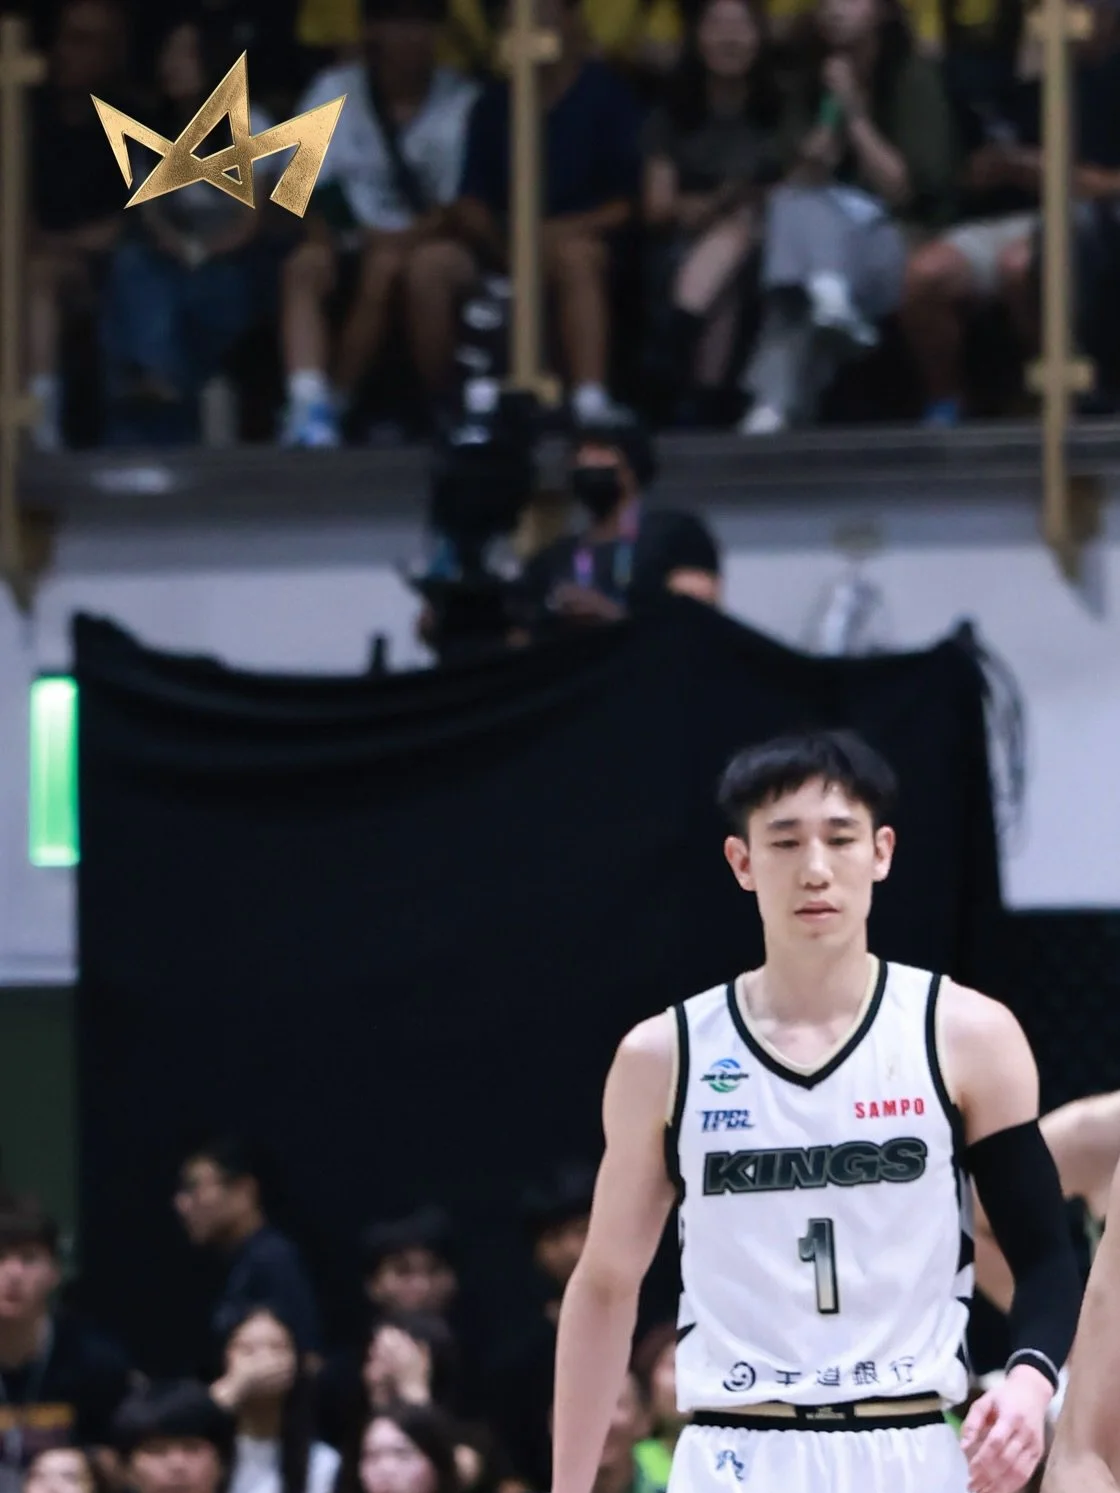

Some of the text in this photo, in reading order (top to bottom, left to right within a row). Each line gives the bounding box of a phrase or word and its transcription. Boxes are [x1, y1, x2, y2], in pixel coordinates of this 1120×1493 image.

[854, 1098, 925, 1119] SAMPO
[703, 1137, 928, 1196] KINGS
[798, 1217, 840, 1315] 1
